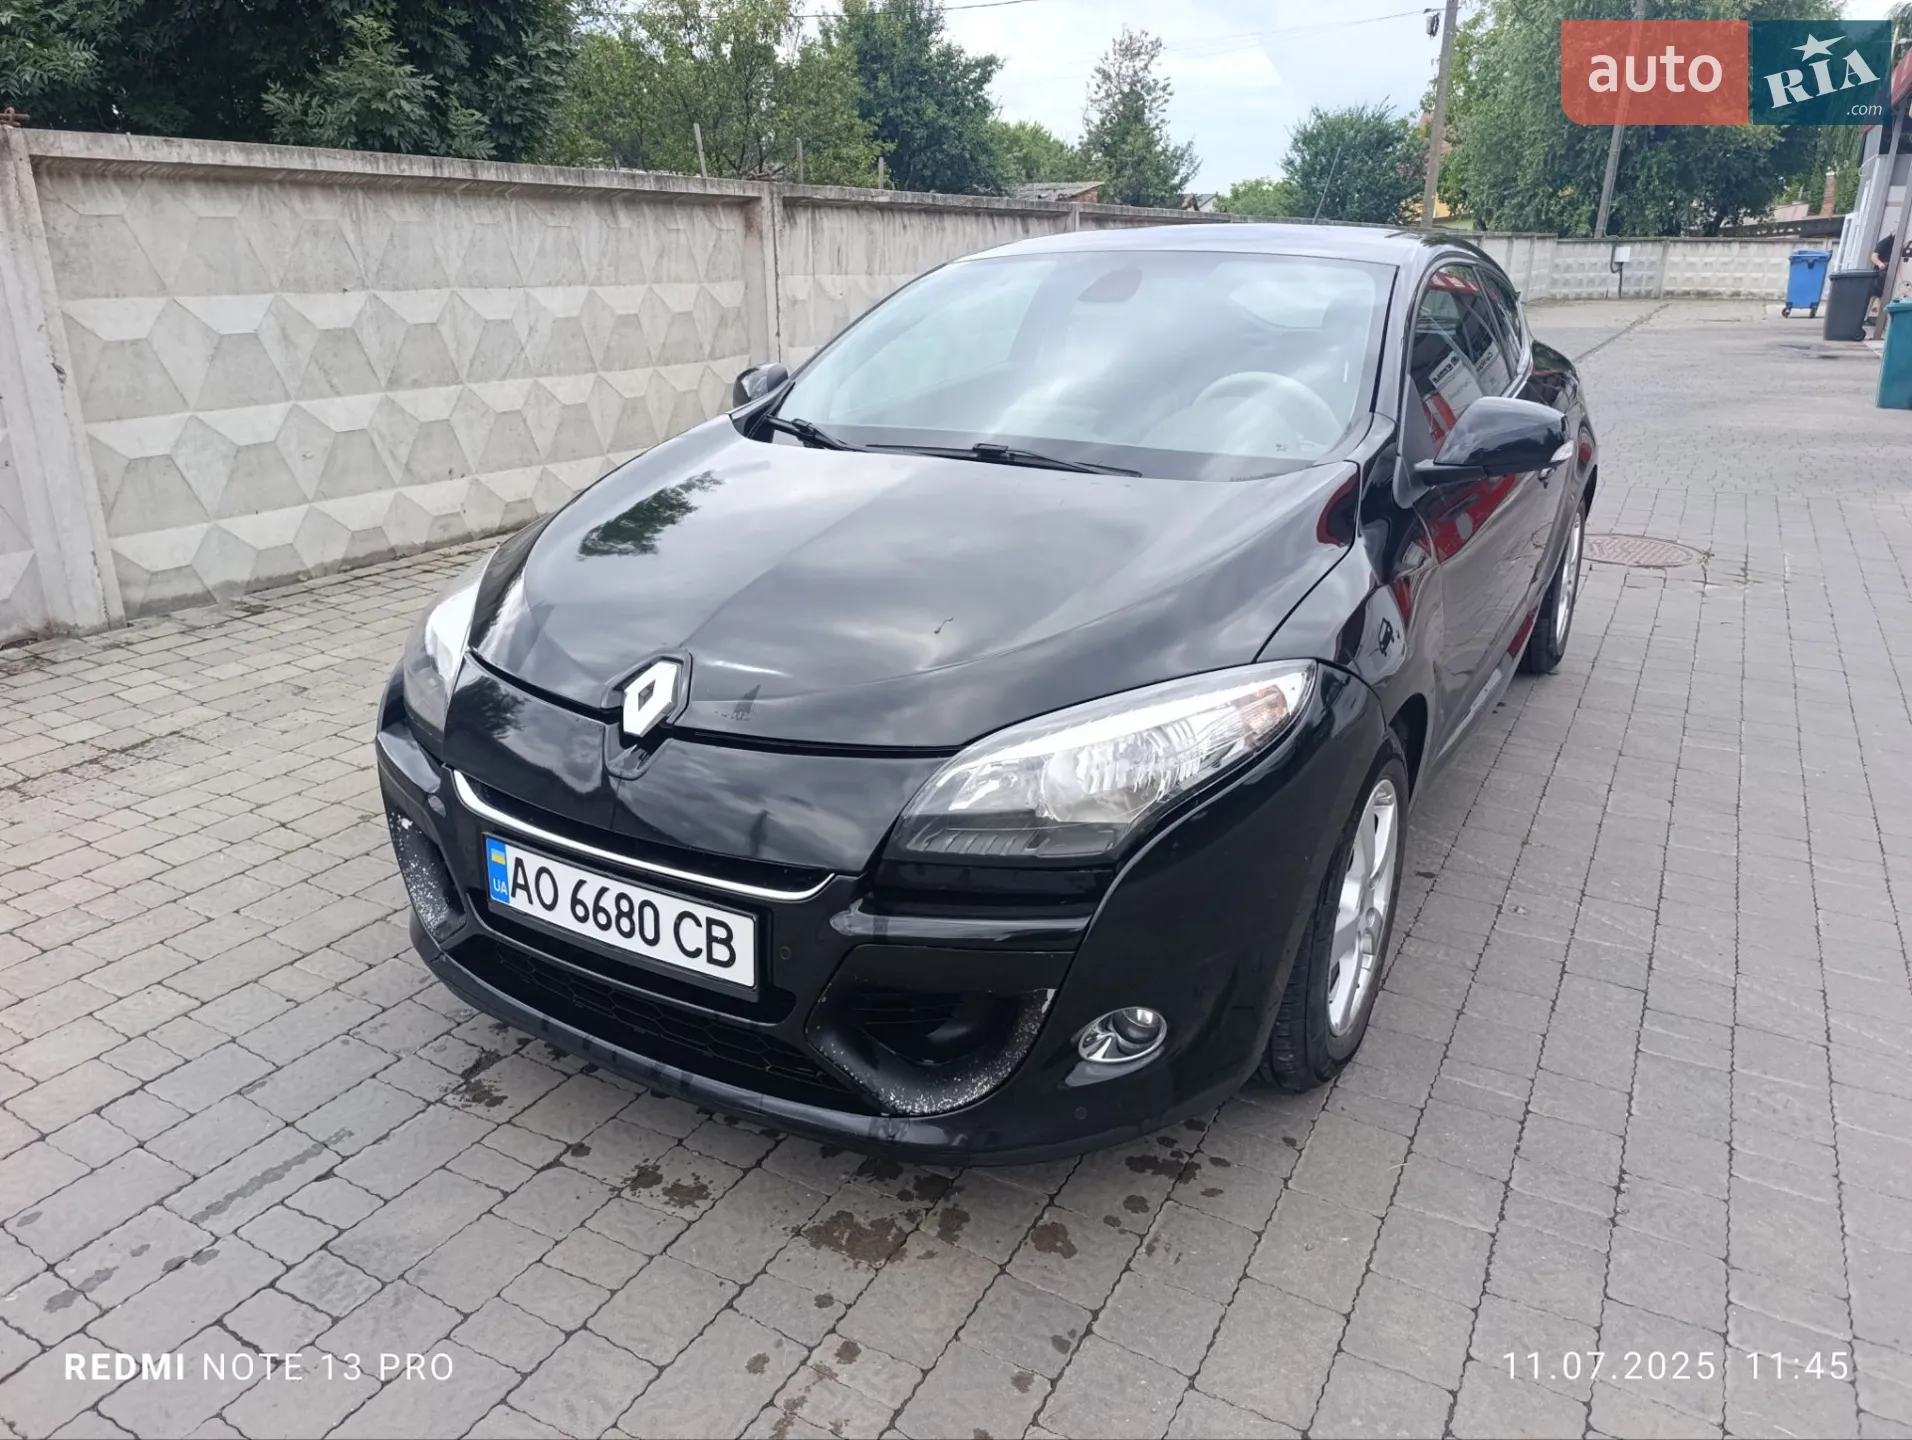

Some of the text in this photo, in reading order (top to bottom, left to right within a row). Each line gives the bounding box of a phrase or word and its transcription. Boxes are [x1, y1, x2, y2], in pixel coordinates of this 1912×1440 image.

[493, 877, 508, 896] UA
[510, 856, 737, 969] AO 6680 CB
